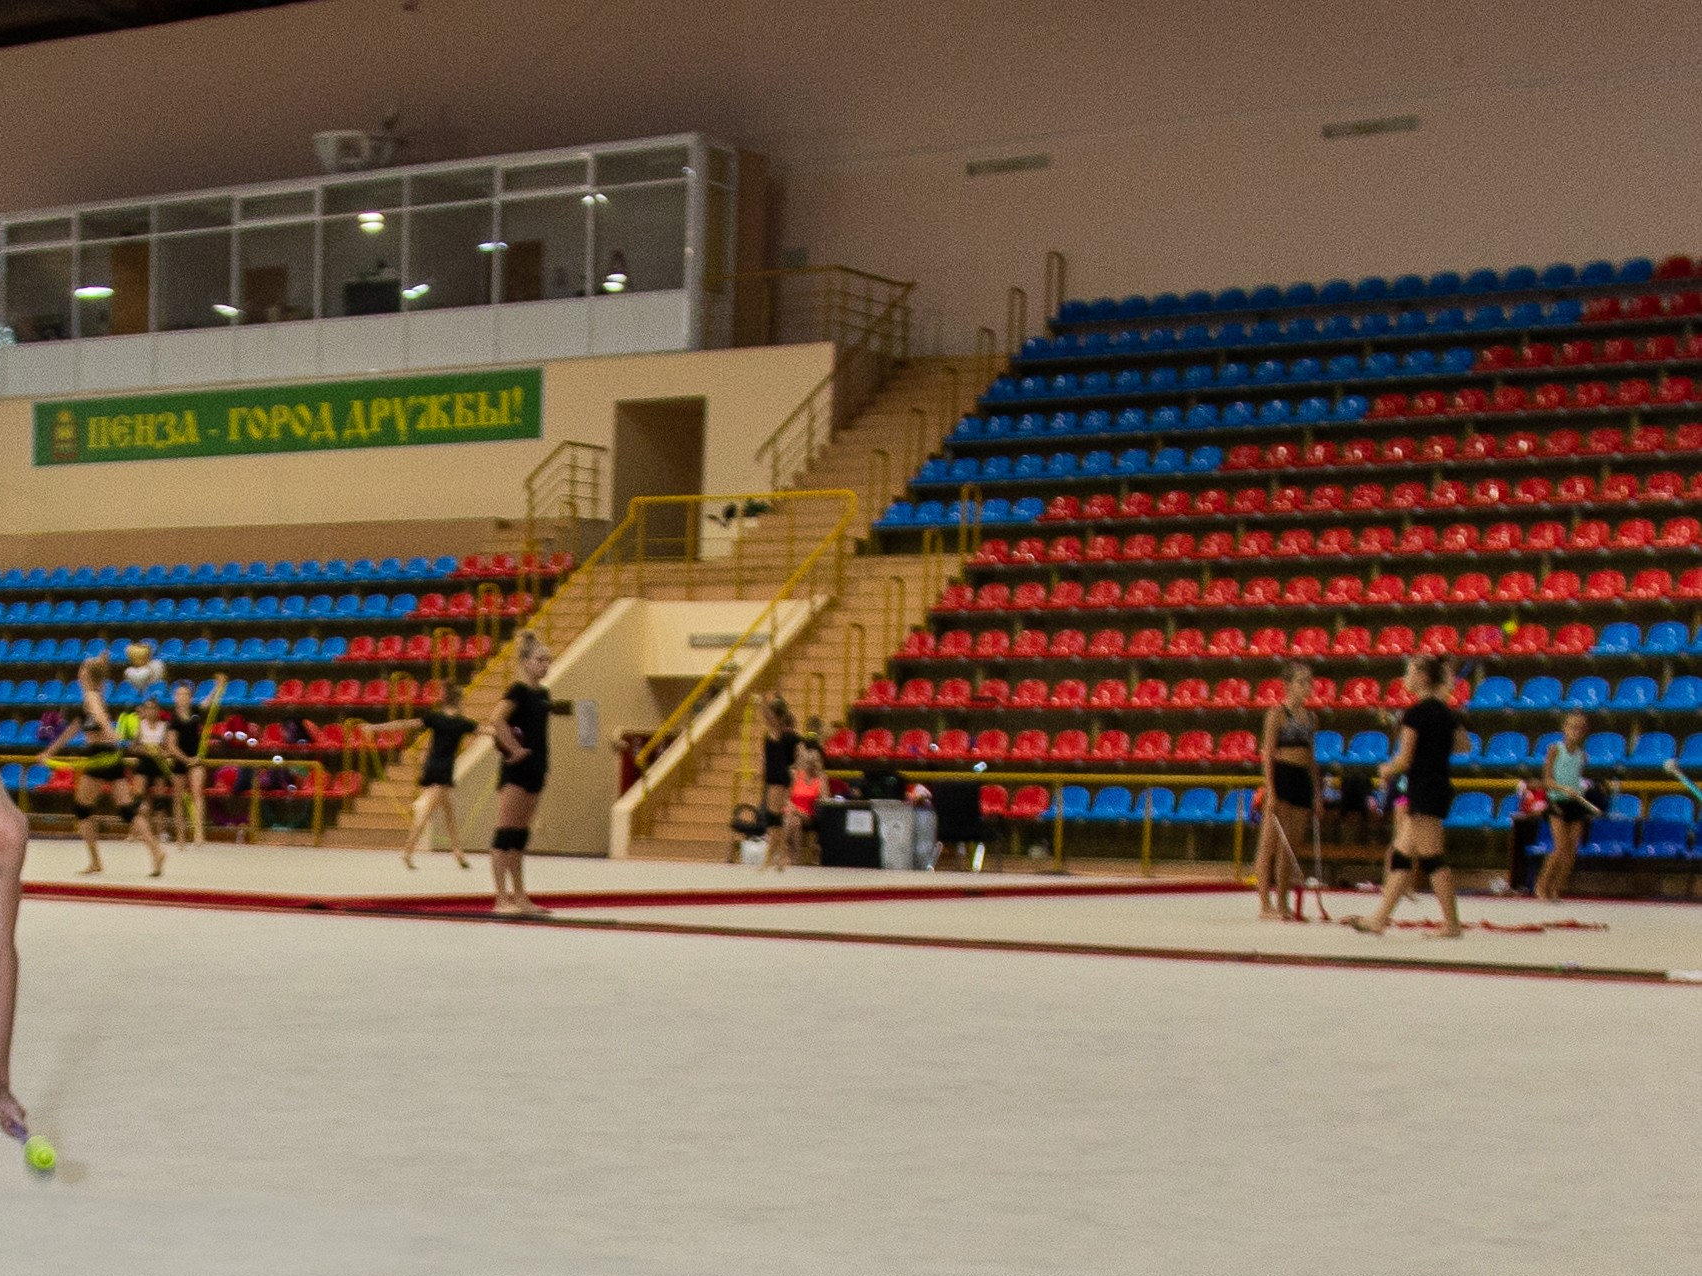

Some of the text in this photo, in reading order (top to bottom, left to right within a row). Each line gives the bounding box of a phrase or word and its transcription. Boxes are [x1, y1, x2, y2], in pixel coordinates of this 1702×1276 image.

[87, 410, 199, 450] ПЕНЗА
[229, 402, 336, 443] ГОРОД
[343, 386, 523, 442] ДРУЖБЫ!
